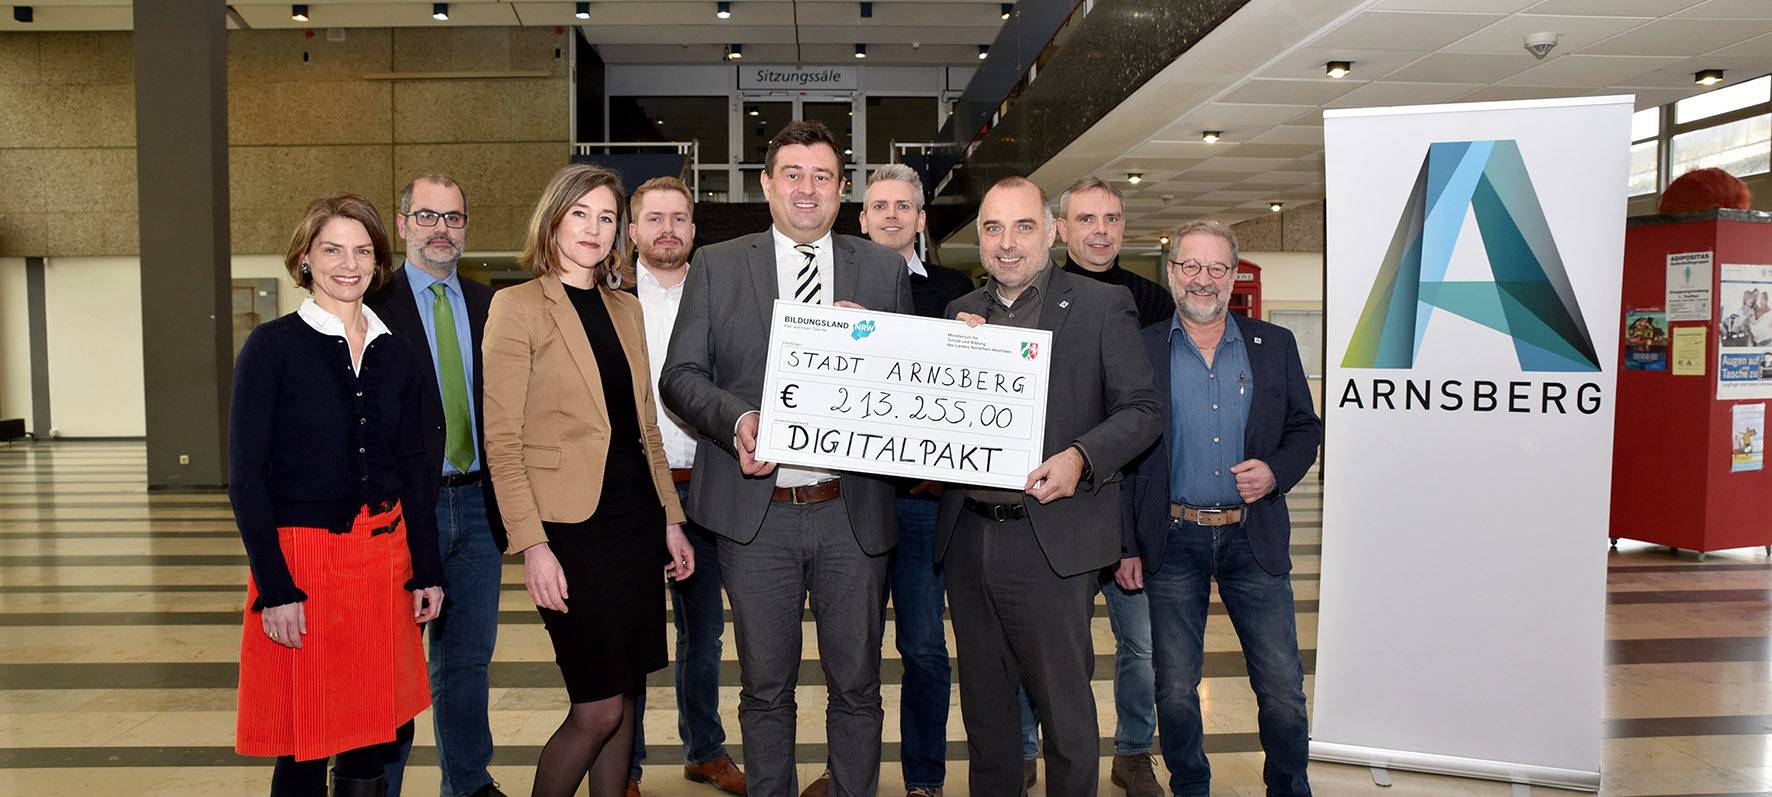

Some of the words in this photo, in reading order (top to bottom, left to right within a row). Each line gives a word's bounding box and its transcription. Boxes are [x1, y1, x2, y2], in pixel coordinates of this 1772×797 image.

[756, 69, 841, 85] Sitzungssäle
[784, 315, 849, 330] BILDUNGSLAND
[854, 323, 875, 332] NRW
[1722, 355, 1748, 367] Augen
[787, 351, 864, 374] STADT
[886, 362, 1026, 394] ARNSBERG
[1721, 368, 1749, 379] Tasche
[1339, 378, 1602, 415] ARNSBERG
[788, 425, 1003, 473] DIGITALPAKT
